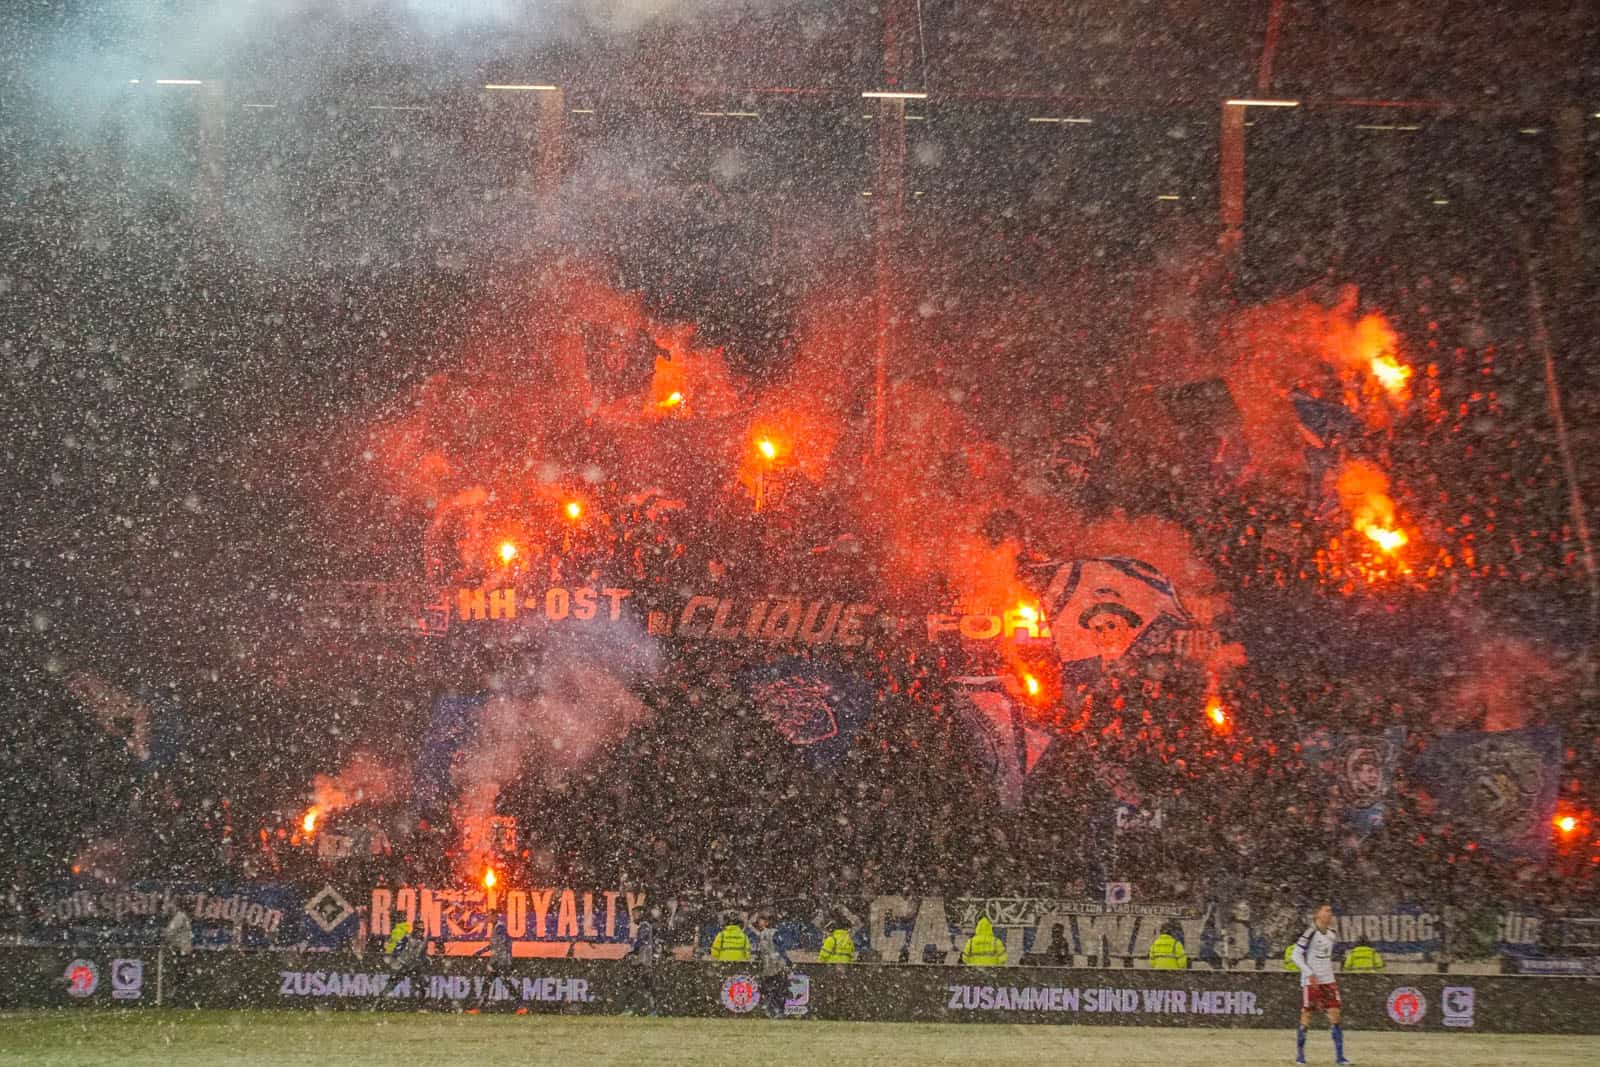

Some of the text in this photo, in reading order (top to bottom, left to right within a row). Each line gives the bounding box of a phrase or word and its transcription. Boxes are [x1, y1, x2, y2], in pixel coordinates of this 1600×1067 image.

[948, 985, 1264, 1015] ZUSAMMEN SIND WIR MEHR.
